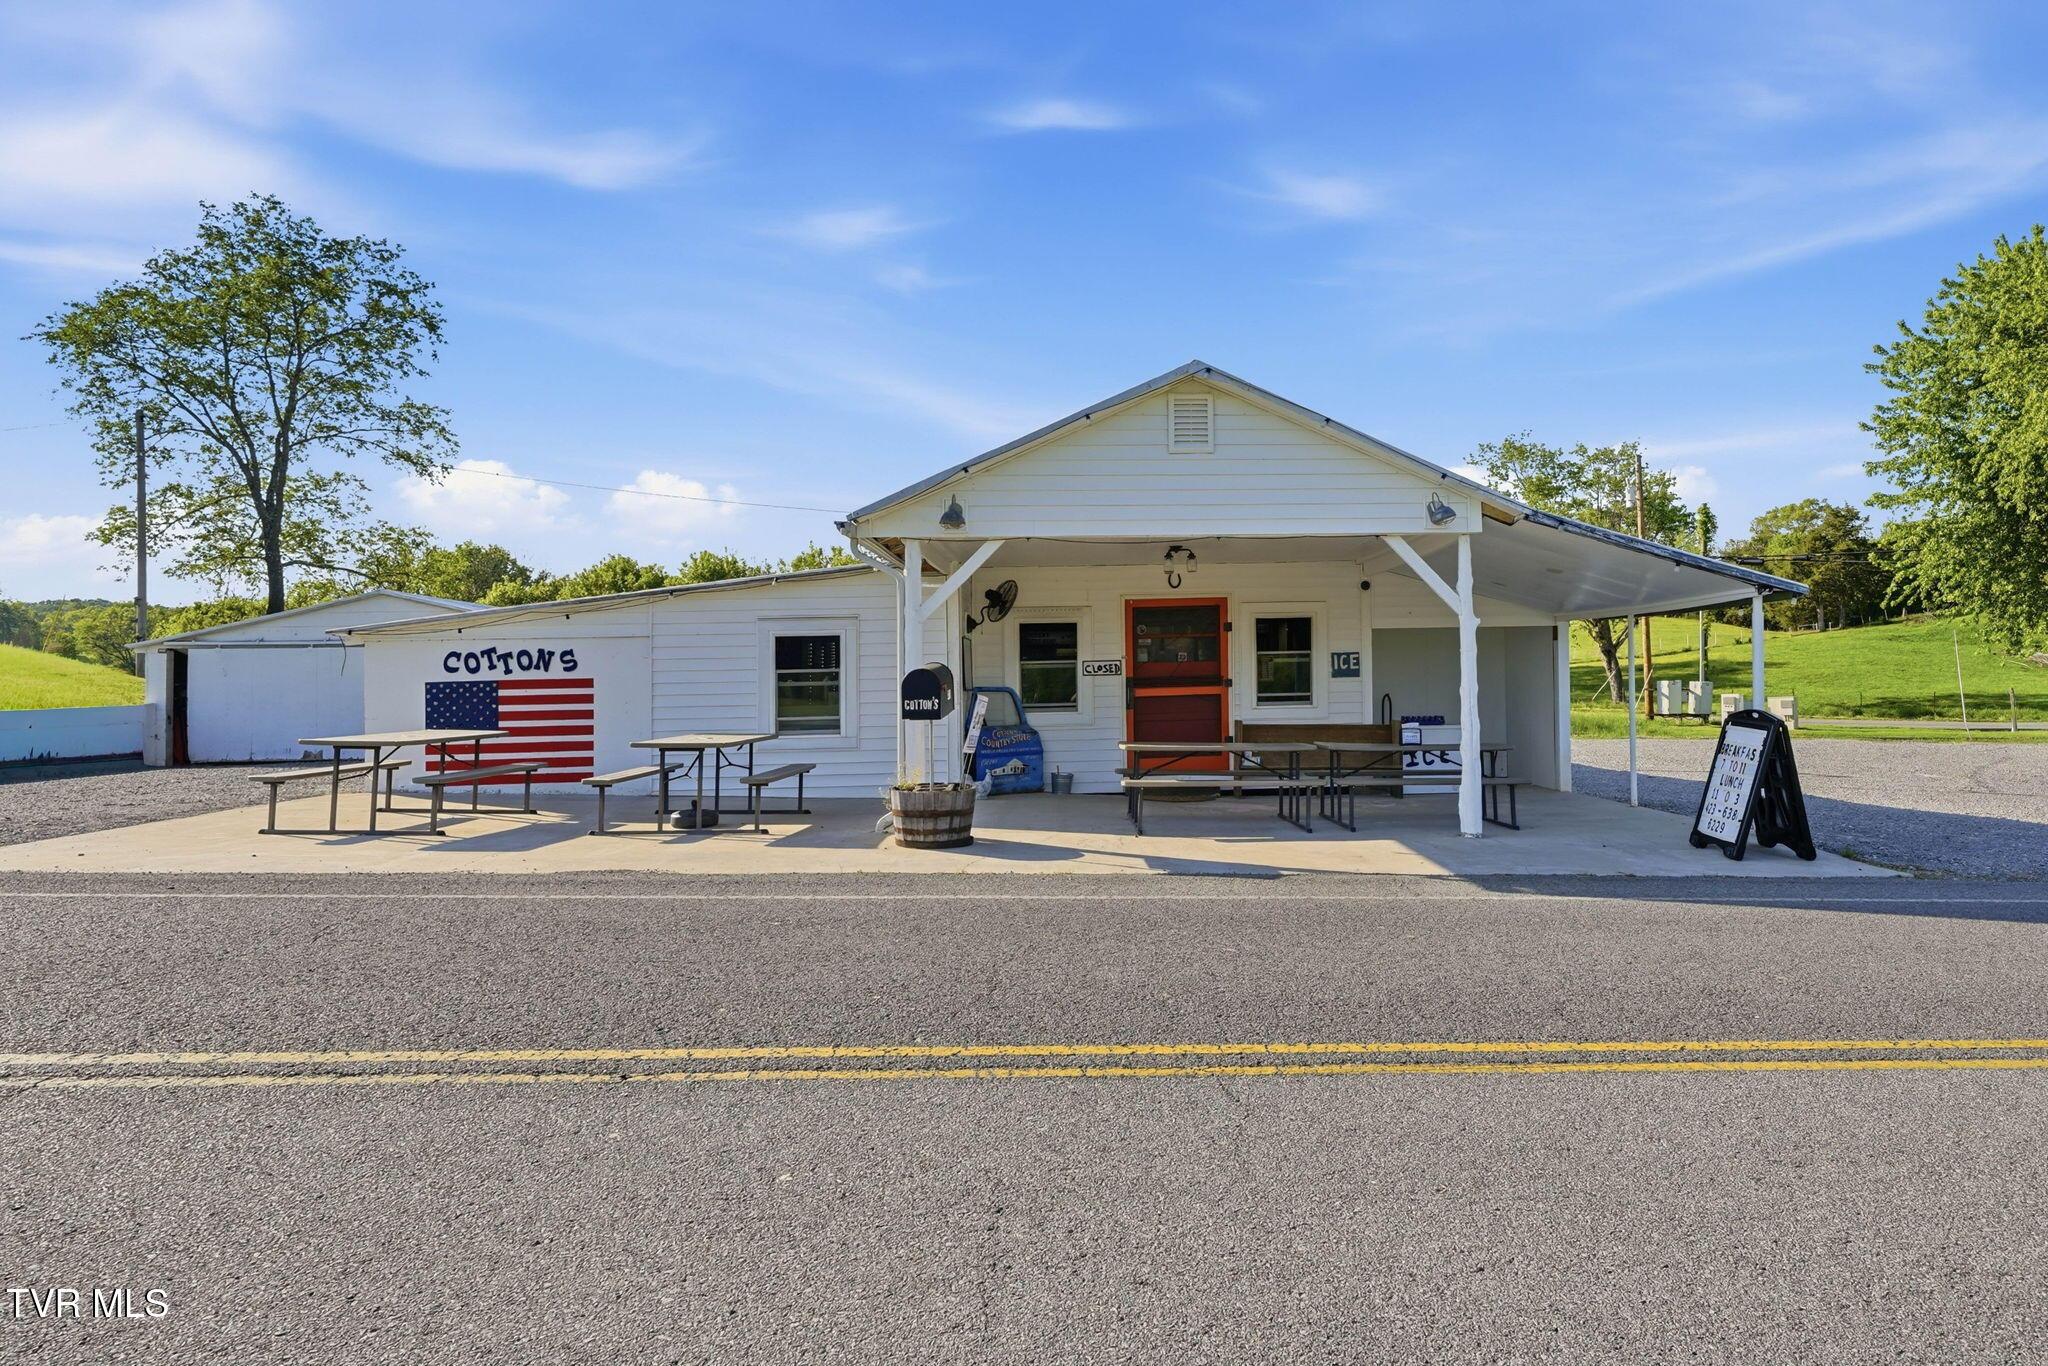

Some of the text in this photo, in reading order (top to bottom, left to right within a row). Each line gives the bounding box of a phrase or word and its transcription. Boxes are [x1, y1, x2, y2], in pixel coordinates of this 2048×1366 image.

[1085, 664, 1120, 673] CLOSED
[1333, 654, 1359, 669] ICE
[1719, 774, 1745, 789] LUNCH
